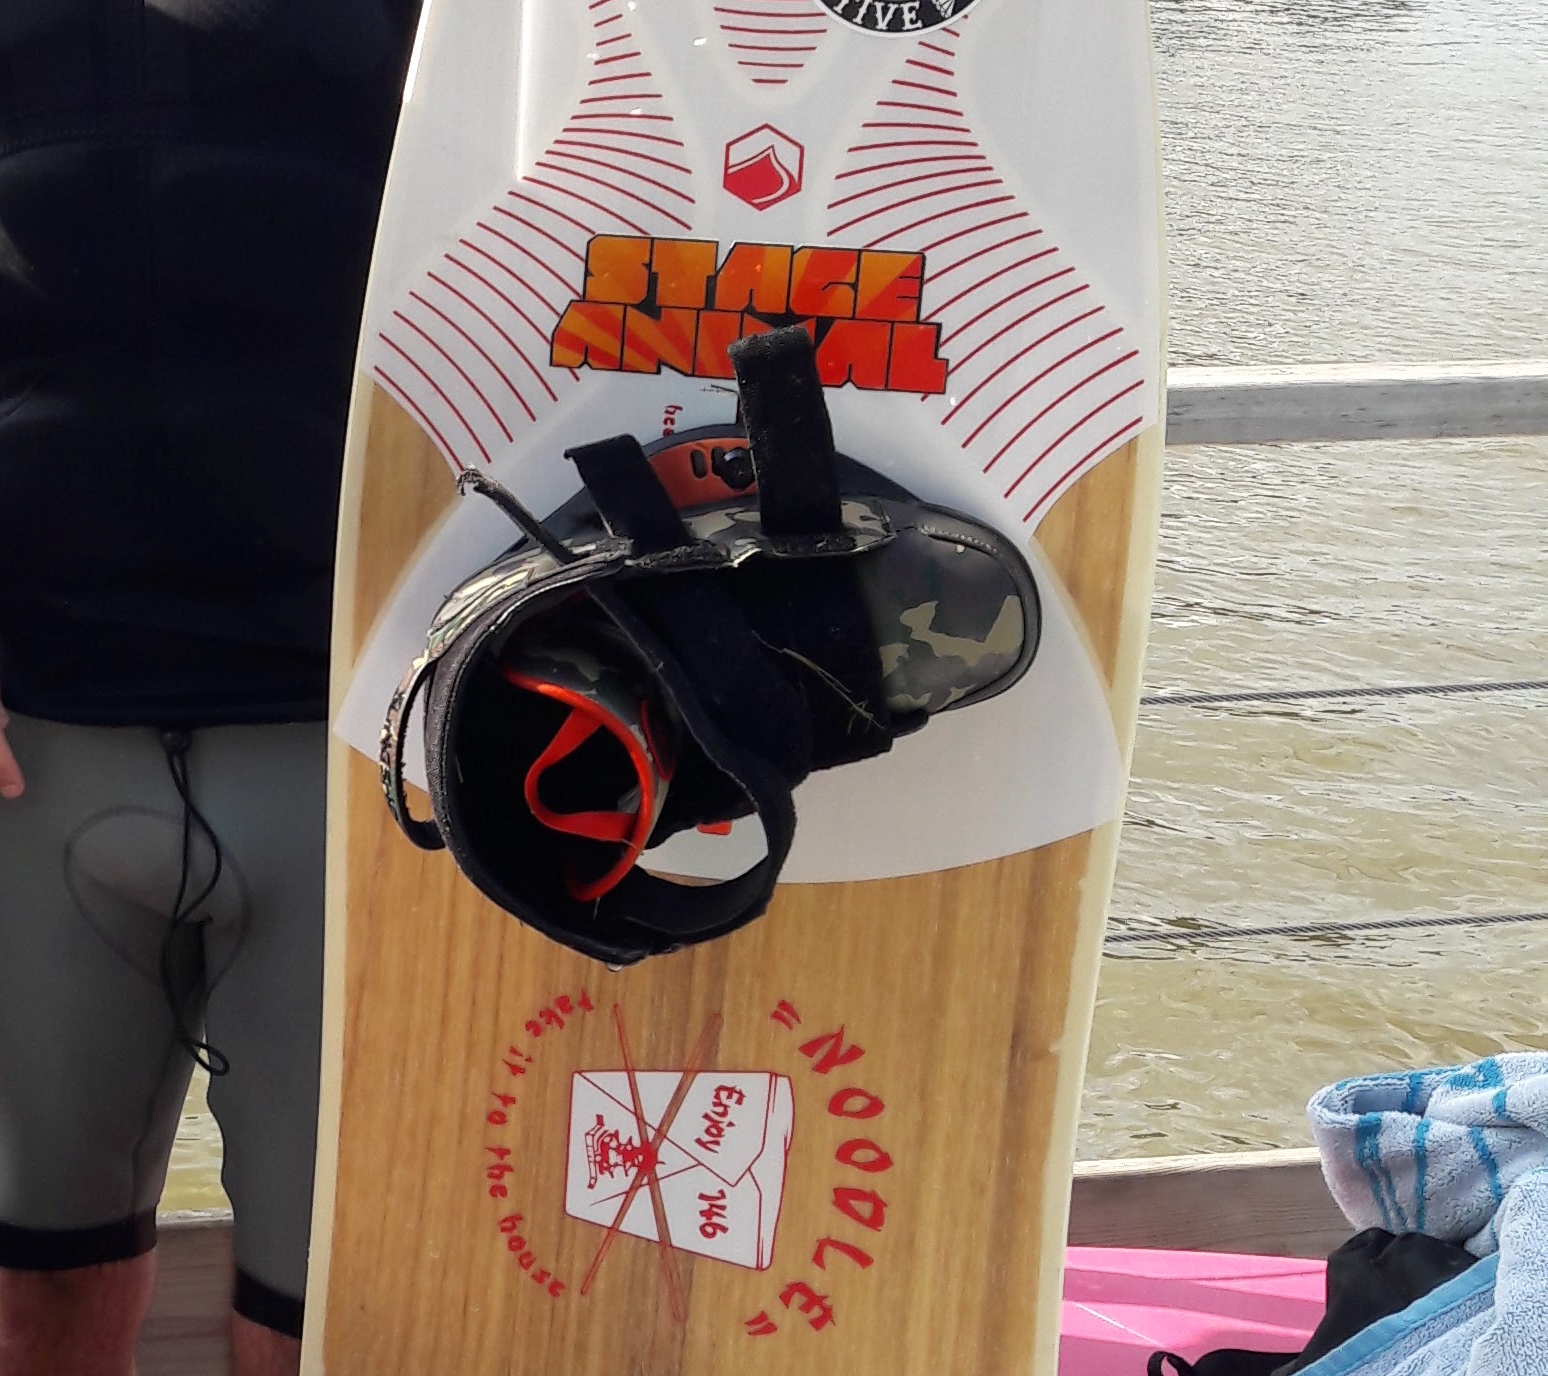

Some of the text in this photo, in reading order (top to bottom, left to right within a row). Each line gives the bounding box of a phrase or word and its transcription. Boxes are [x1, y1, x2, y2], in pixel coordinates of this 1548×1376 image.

[584, 233, 927, 323] STAGE
[502, 1046, 533, 1076] it
[487, 1092, 516, 1126] to
[695, 1083, 746, 1154] Enjoy
[485, 1147, 514, 1198] the
[697, 1189, 727, 1241] 146
[499, 1214, 566, 1298] house
